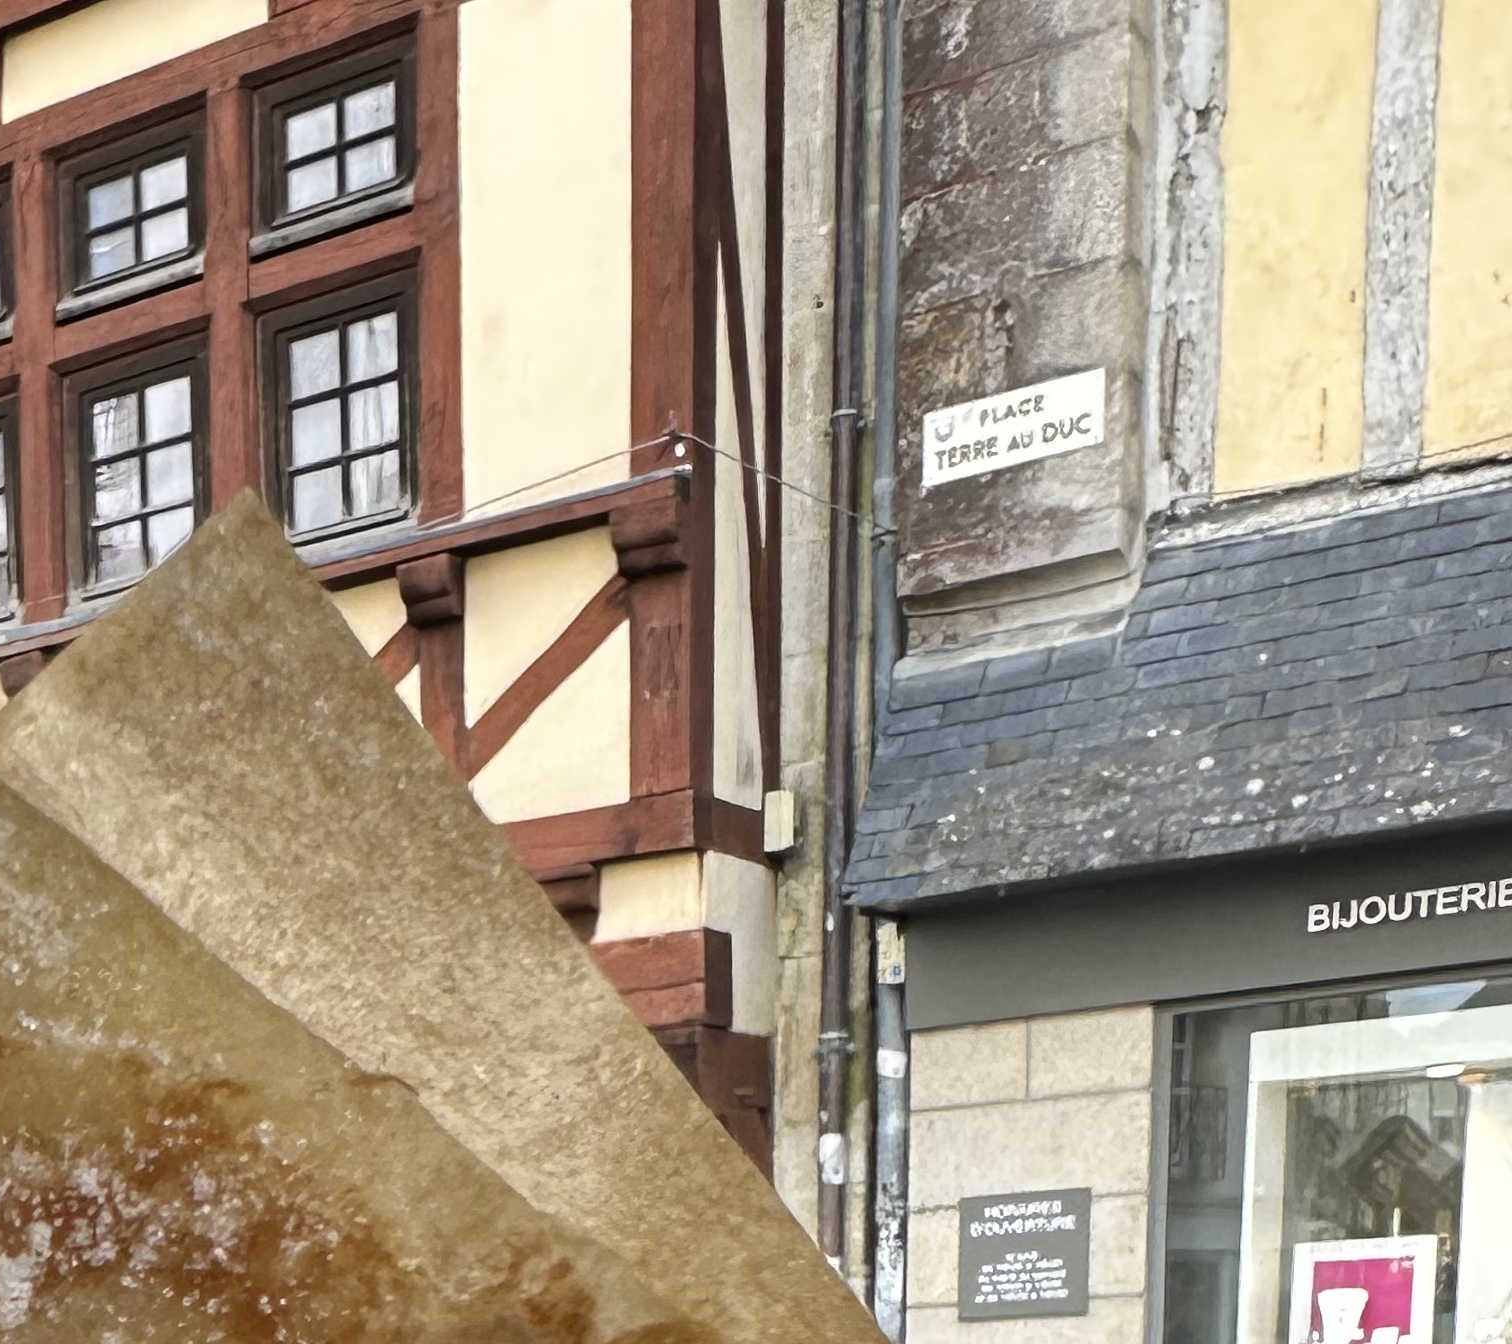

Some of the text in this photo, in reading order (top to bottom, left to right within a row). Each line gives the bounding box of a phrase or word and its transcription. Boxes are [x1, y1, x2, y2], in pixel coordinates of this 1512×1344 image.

[978, 394, 1044, 427] PLACE
[935, 412, 1092, 470] TERRE AU DUC
[1306, 877, 1512, 933] BIJOUTERIE
